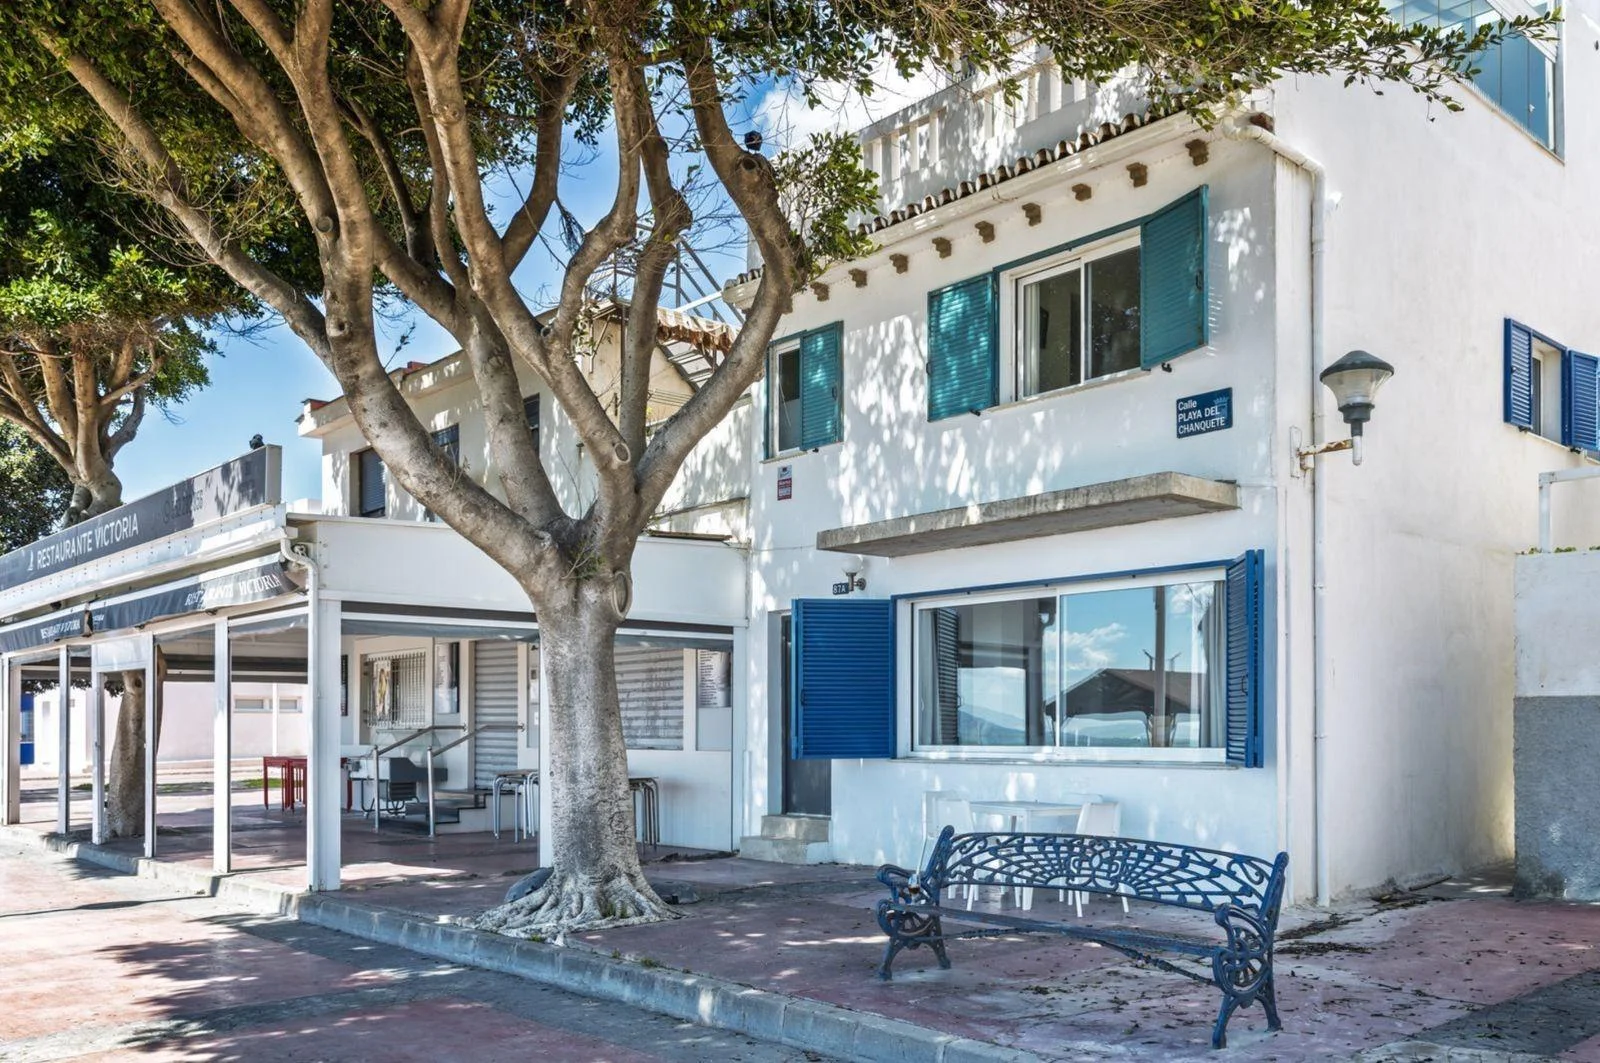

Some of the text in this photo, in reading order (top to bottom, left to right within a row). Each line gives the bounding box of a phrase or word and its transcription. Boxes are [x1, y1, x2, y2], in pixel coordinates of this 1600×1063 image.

[1178, 400, 1197, 411] Calle
[1178, 405, 1220, 423] PLAYA DEL
[1178, 417, 1225, 435] CHANQUETE
[37, 513, 139, 570] RESTAURANTE VICTORIA
